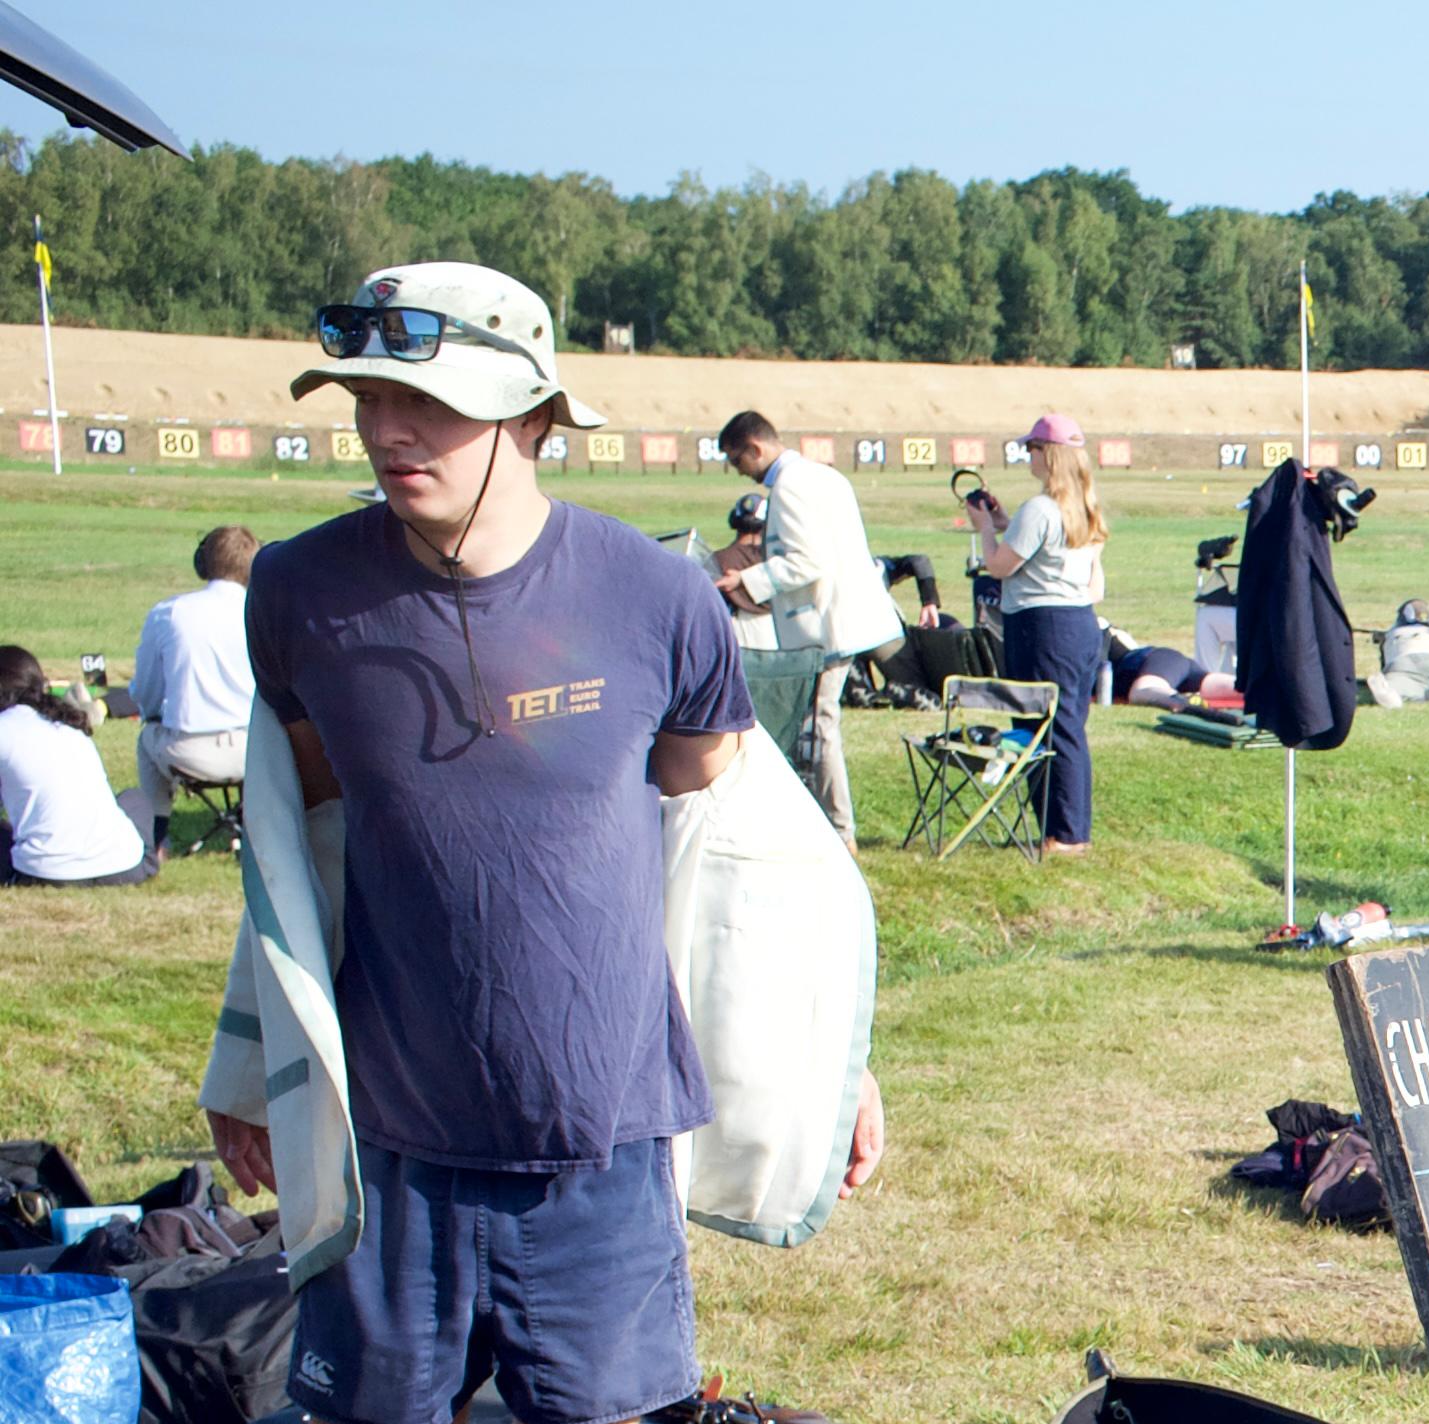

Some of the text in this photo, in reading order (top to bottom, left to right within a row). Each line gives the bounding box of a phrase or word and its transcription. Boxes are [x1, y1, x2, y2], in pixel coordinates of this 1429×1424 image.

[88, 429, 123, 453] 79
[164, 433, 194, 453] 80
[218, 432, 246, 455] 81
[276, 437, 309, 460] 82
[593, 438, 620, 457] 86
[857, 440, 885, 463] 91
[908, 443, 932, 460] 92
[1004, 440, 1031, 463] 94
[1220, 444, 1247, 465] 97
[1356, 445, 1380, 465] 00
[1403, 447, 1423, 463] 01
[569, 678, 605, 691] TRANS
[507, 685, 564, 721] TET
[569, 690, 601, 703] EURO
[569, 701, 601, 714] TRAIL
